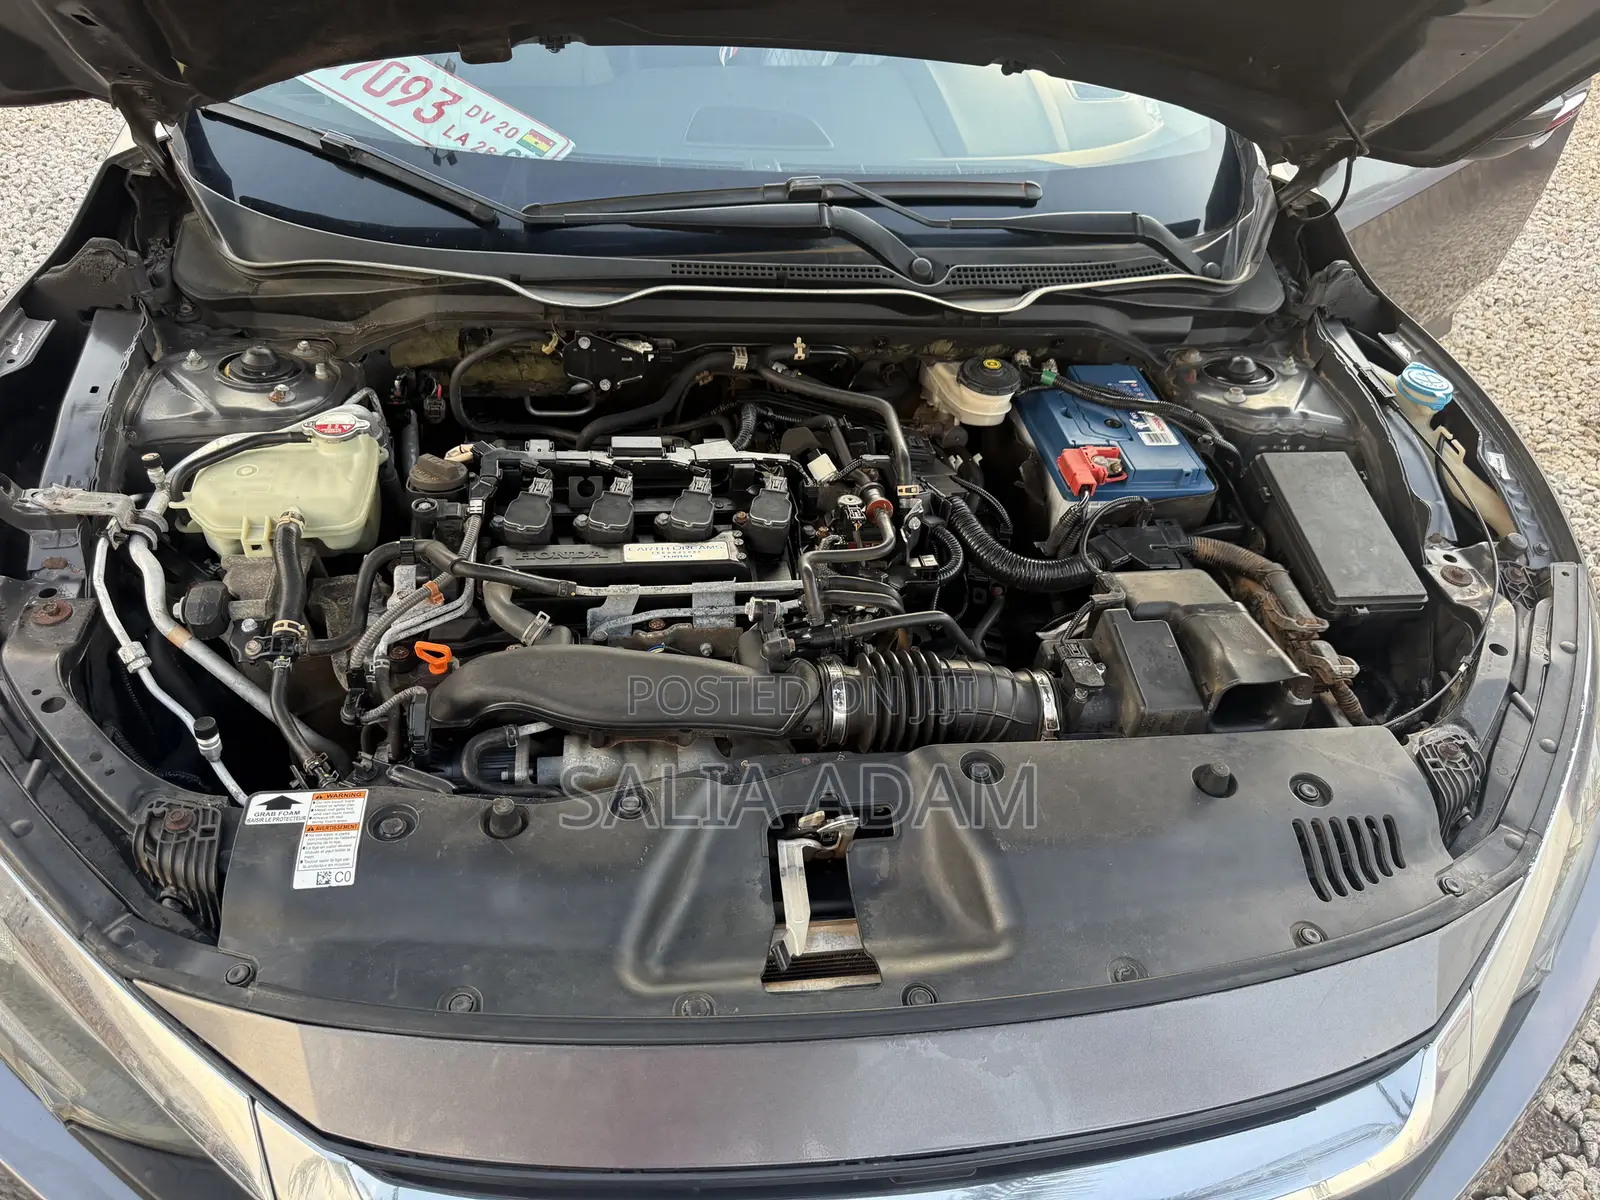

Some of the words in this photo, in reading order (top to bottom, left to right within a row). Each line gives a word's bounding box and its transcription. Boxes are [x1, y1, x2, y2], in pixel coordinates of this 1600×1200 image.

[464, 104, 496, 124] DV
[493, 121, 519, 139] 20
[442, 124, 470, 146] LA
[326, 791, 362, 799] WARNING
